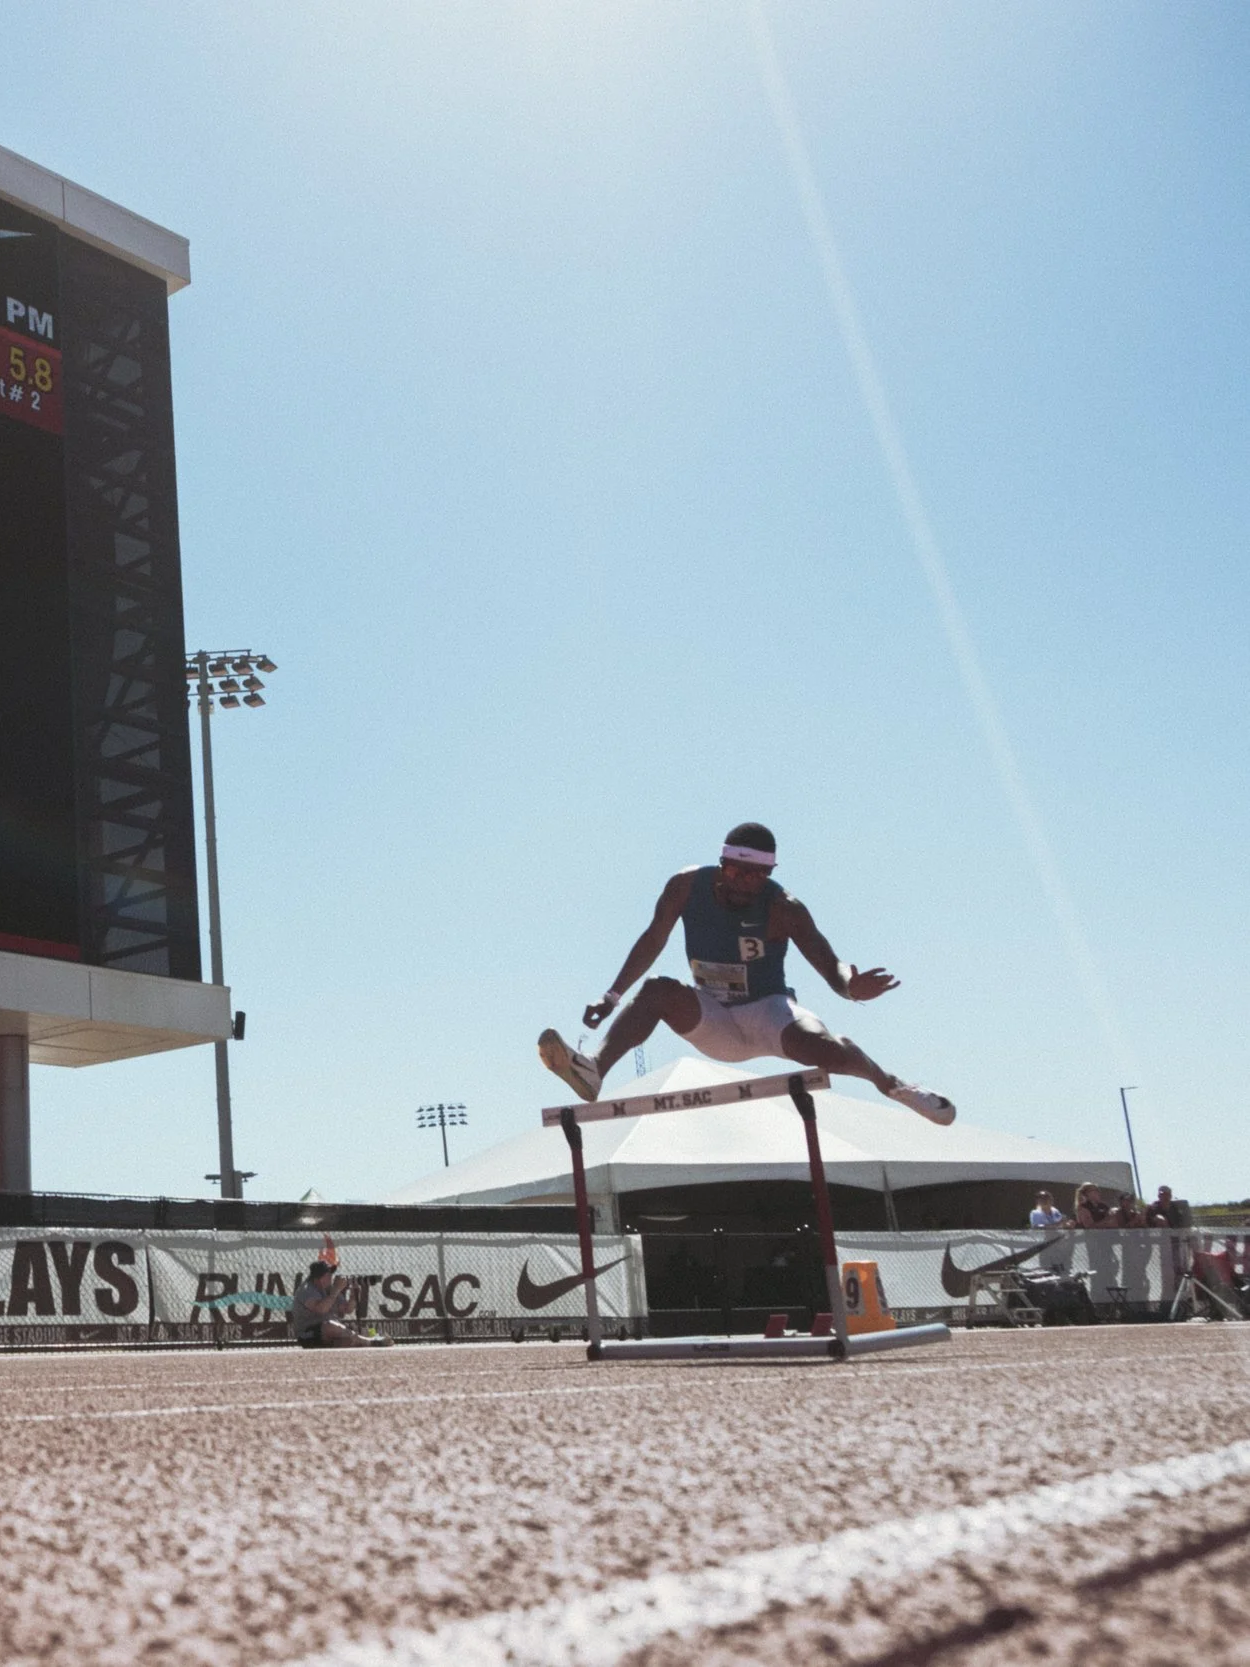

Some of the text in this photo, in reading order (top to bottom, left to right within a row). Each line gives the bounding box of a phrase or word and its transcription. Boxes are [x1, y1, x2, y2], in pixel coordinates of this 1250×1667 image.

[6, 297, 53, 340] PM
[9, 346, 53, 392] 5.8
[30, 390, 41, 411] 2
[745, 938, 759, 960] 3
[654, 1094, 680, 1111] MT.
[683, 1090, 712, 1106] SAC
[846, 1277, 859, 1309] 9
[14, 1326, 66, 1344] STADIUM
[178, 1324, 198, 1341] SAC
[472, 1320, 492, 1337] SAC
